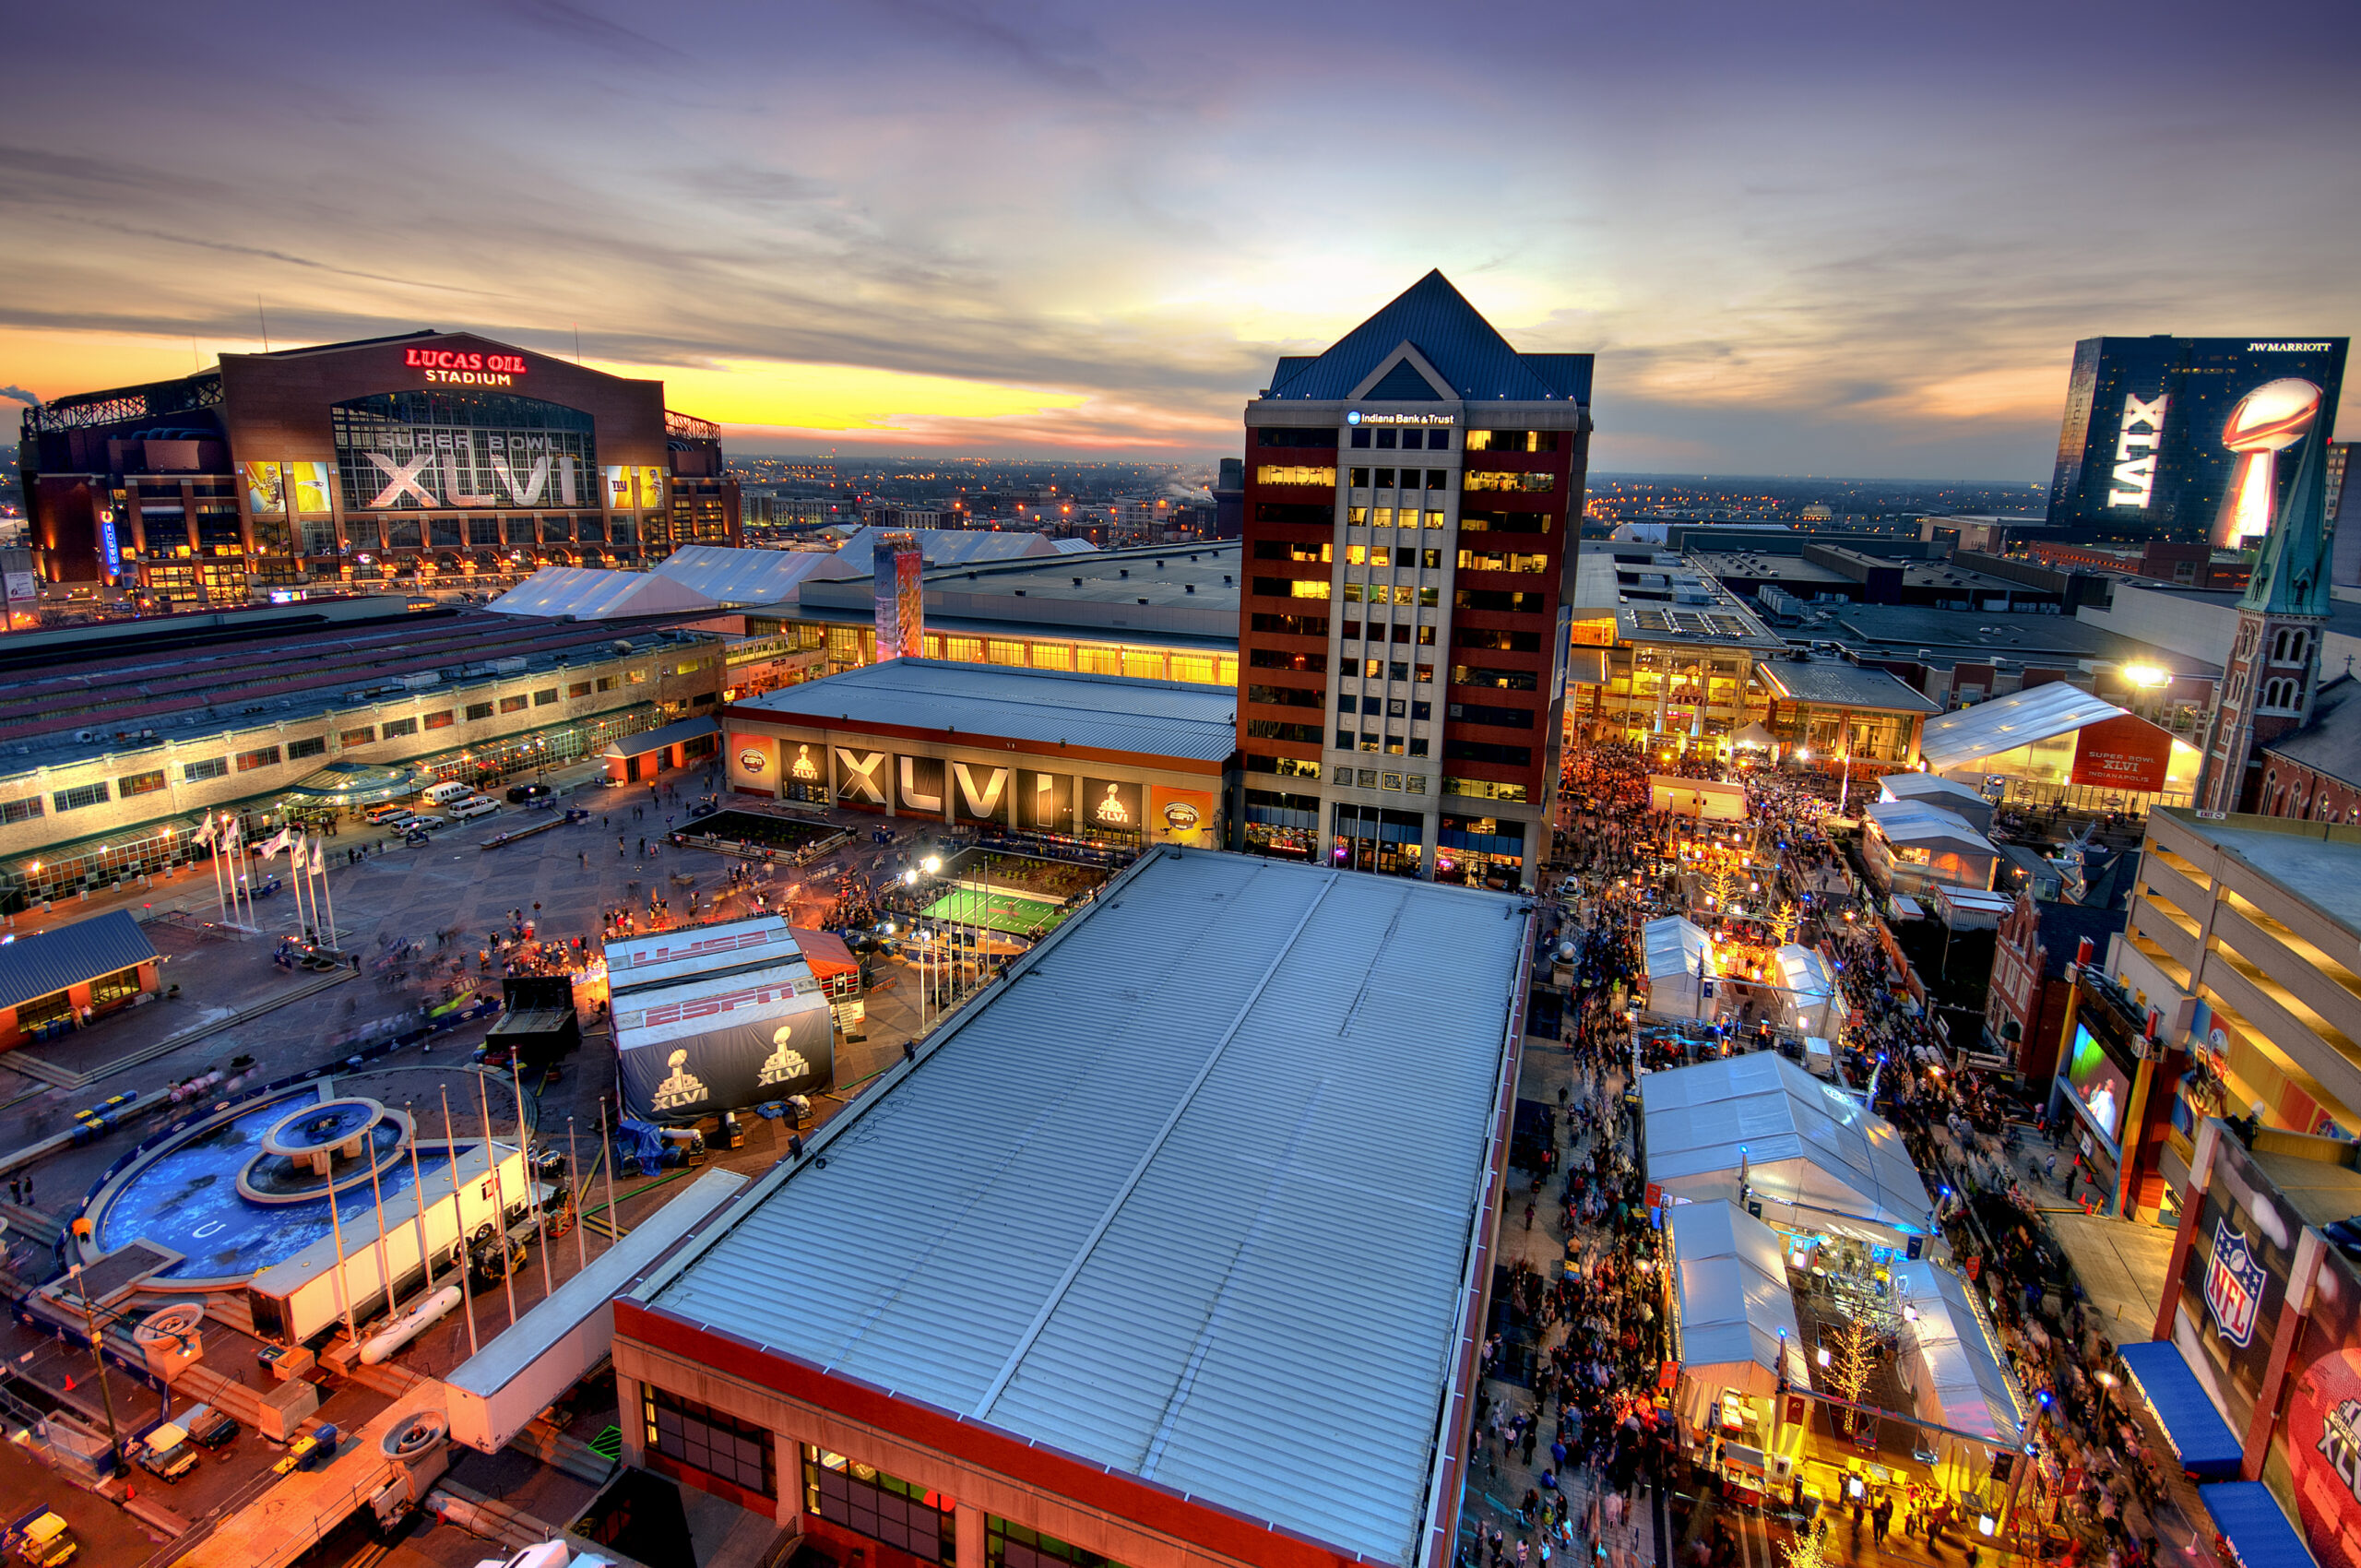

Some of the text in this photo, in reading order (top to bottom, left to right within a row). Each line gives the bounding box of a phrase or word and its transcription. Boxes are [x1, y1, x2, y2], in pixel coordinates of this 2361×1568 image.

[406, 349, 527, 374] LUCAS OIL
[425, 370, 511, 386] STADIUM
[1361, 414, 1454, 424] Indiana Bank & Trust
[376, 432, 561, 450] SUPER BOWL
[2107, 393, 2168, 508] XLVI
[363, 452, 576, 508] XLVI
[2088, 752, 2155, 764] SUPER BOWL
[2103, 759, 2139, 772] XLVI
[791, 768, 818, 779] XLVI
[2089, 771, 2149, 782] INDIANAPOLIS
[836, 748, 1053, 827] XLVI
[1096, 810, 1128, 823] XLVI
[1169, 812, 1194, 822] ESPN
[646, 981, 794, 1027] ESPN
[756, 1063, 810, 1087] XLVI
[650, 1087, 708, 1112] XLVI
[2209, 1262, 2246, 1335] NFL
[2119, 1353, 2183, 1460] JAPANESE RESTAURANT
[2333, 1415, 2356, 1444] SUPER
